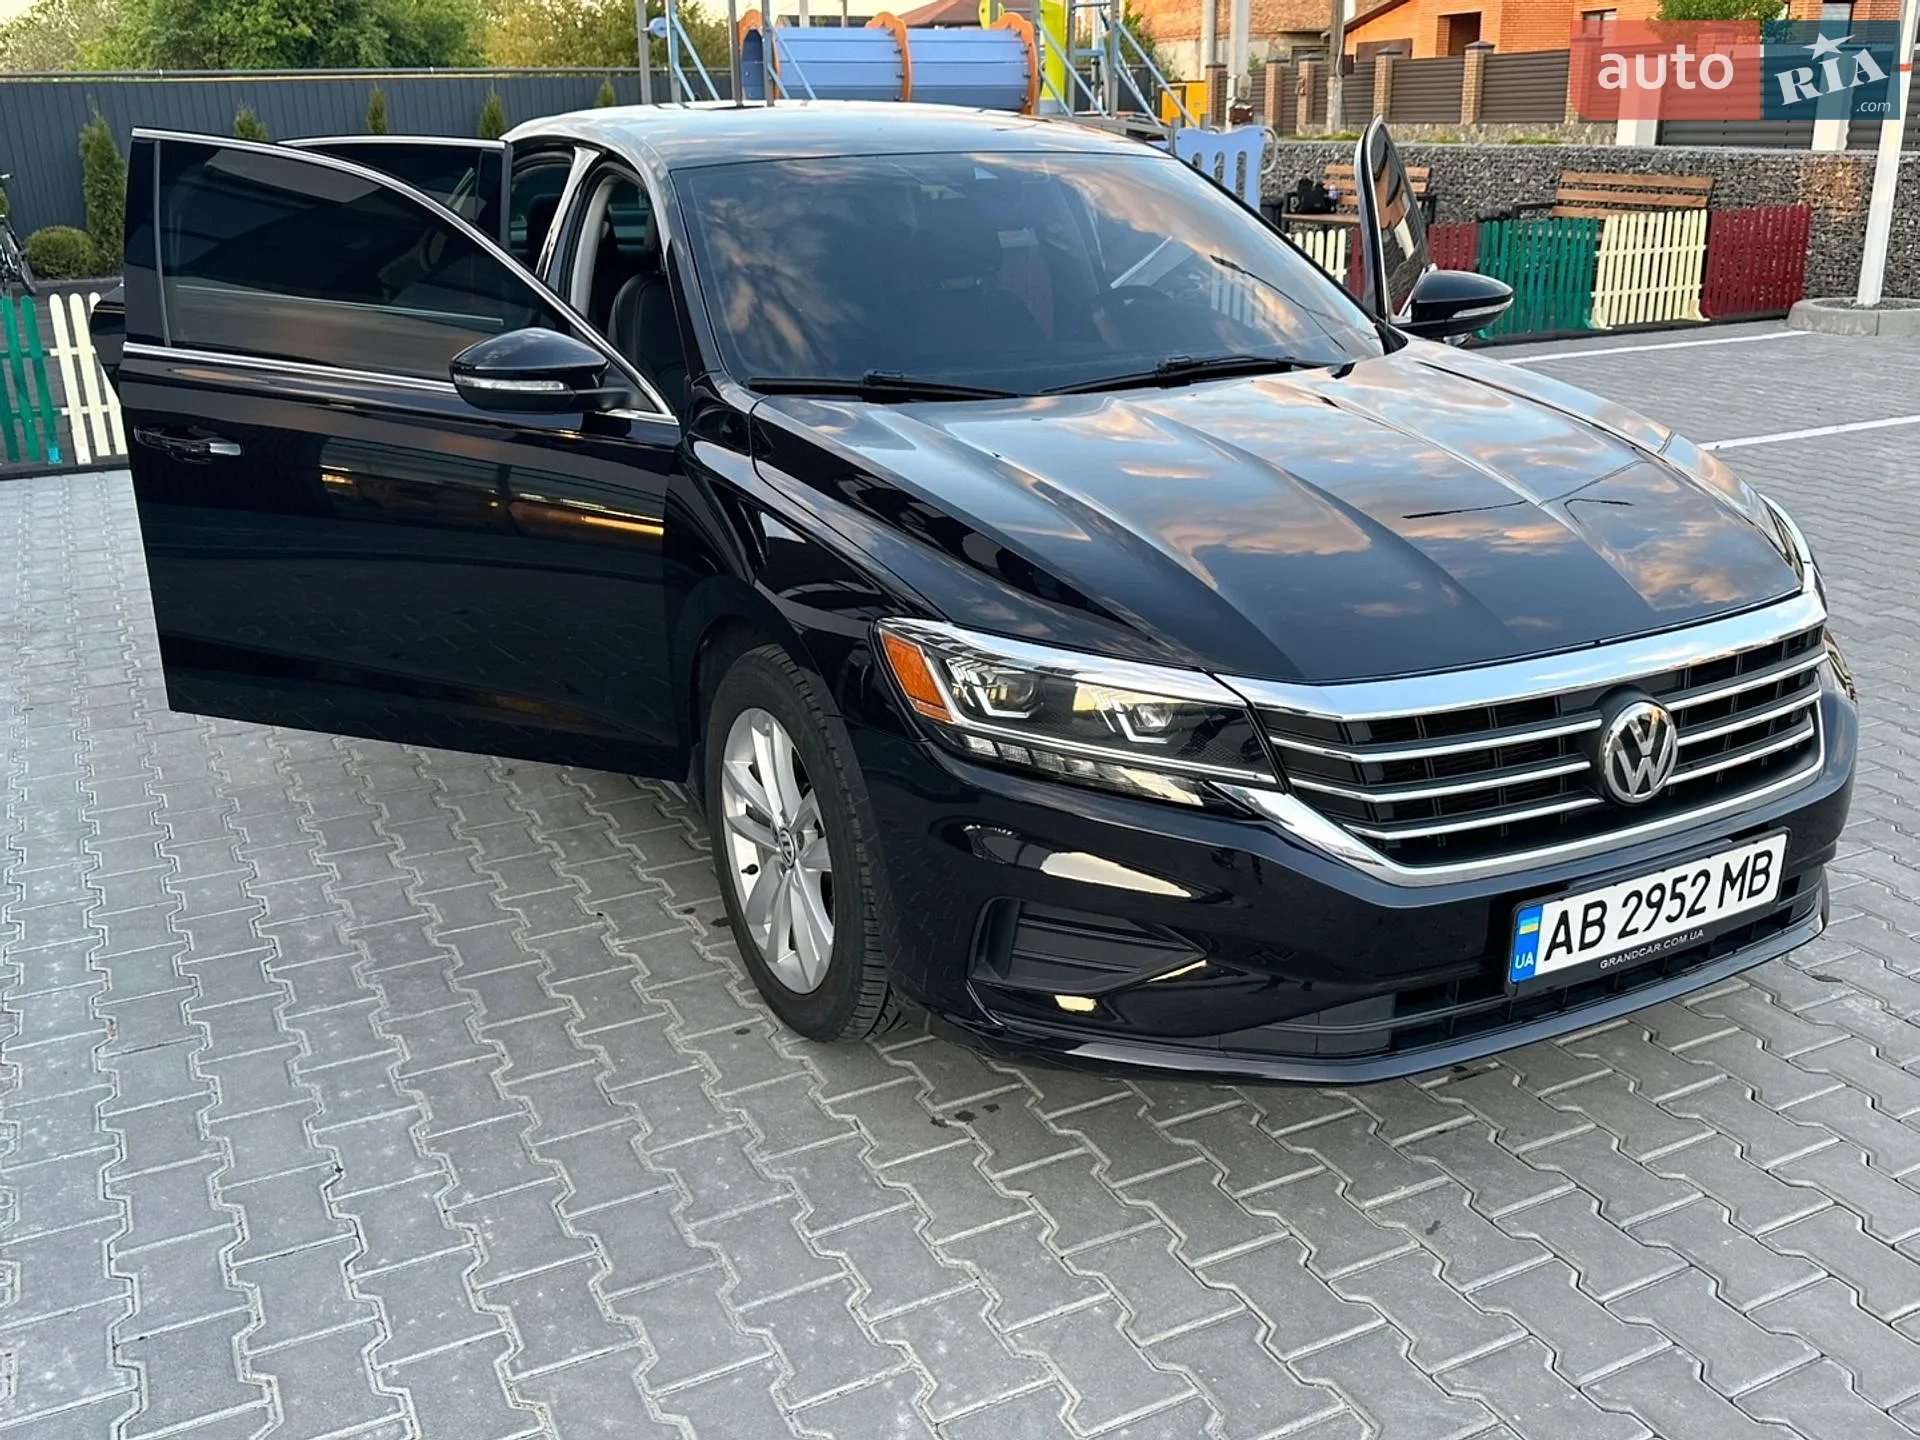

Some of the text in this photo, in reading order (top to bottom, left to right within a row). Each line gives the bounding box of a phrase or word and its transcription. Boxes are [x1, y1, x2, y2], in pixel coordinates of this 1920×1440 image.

[1544, 849, 1774, 962] AB 2952 MB
[1515, 952, 1535, 969] UA
